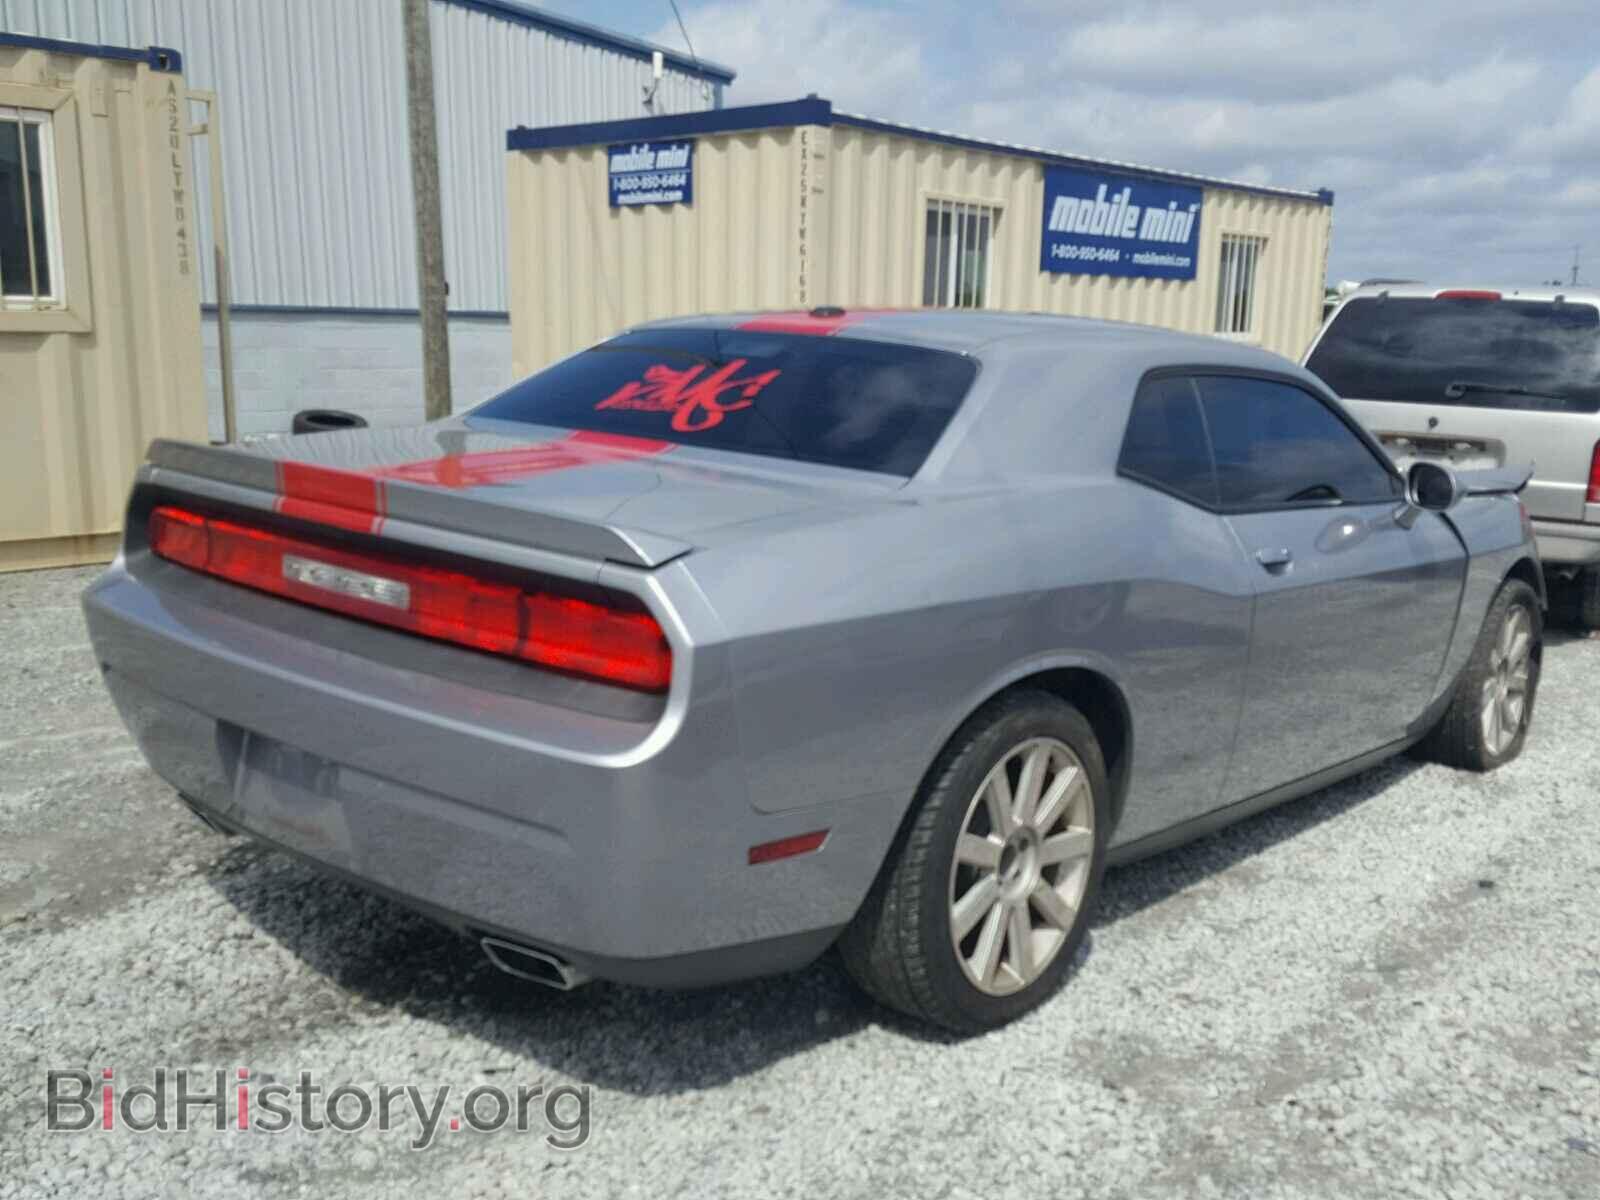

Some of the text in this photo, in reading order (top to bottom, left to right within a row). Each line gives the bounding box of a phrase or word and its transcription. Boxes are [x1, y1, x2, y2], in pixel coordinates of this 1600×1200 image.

[610, 143, 690, 173] mobile mini
[1048, 183, 1197, 244] mobile mini
